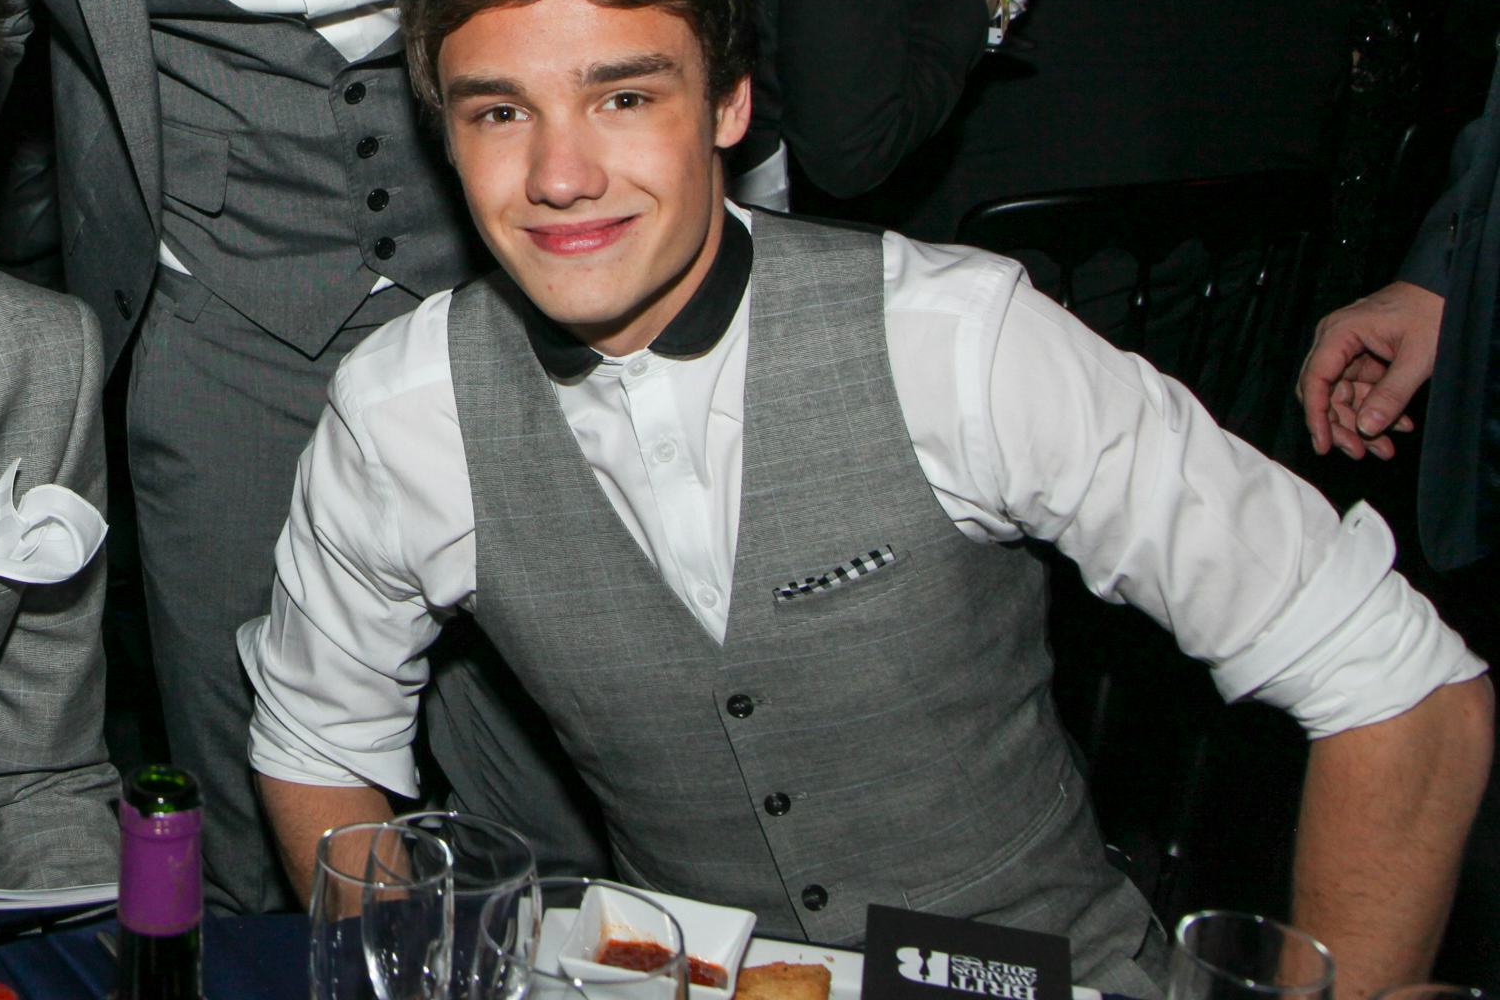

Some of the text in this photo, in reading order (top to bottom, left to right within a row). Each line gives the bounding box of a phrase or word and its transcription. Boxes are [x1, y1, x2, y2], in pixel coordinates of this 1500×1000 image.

[951, 965, 1037, 986] AWARDS
[987, 960, 1038, 977] 2012
[951, 975, 1037, 1000] BRIT
